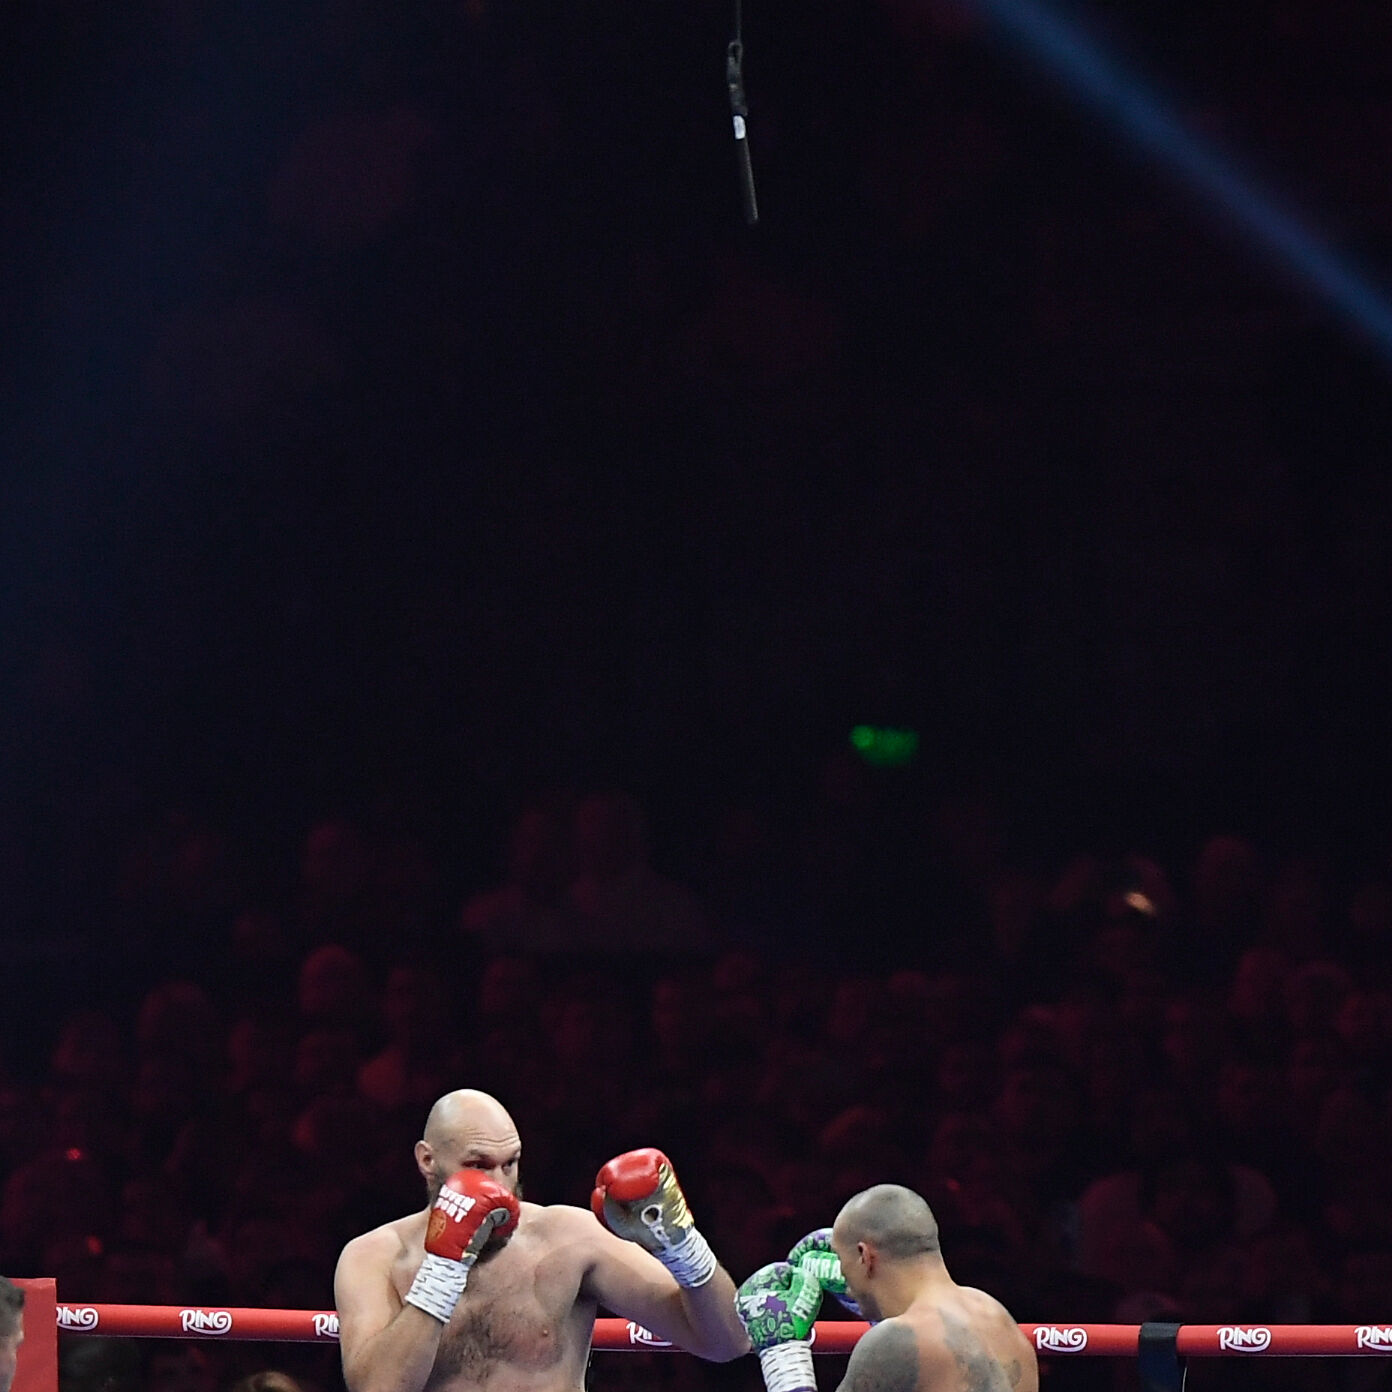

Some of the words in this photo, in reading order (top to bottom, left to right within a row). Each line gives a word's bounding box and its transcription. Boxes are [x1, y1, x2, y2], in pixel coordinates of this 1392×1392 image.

[57, 1306, 99, 1331] ING
[179, 1309, 232, 1335] RING
[1033, 1326, 1087, 1352] RING
[1216, 1327, 1271, 1352] RING
